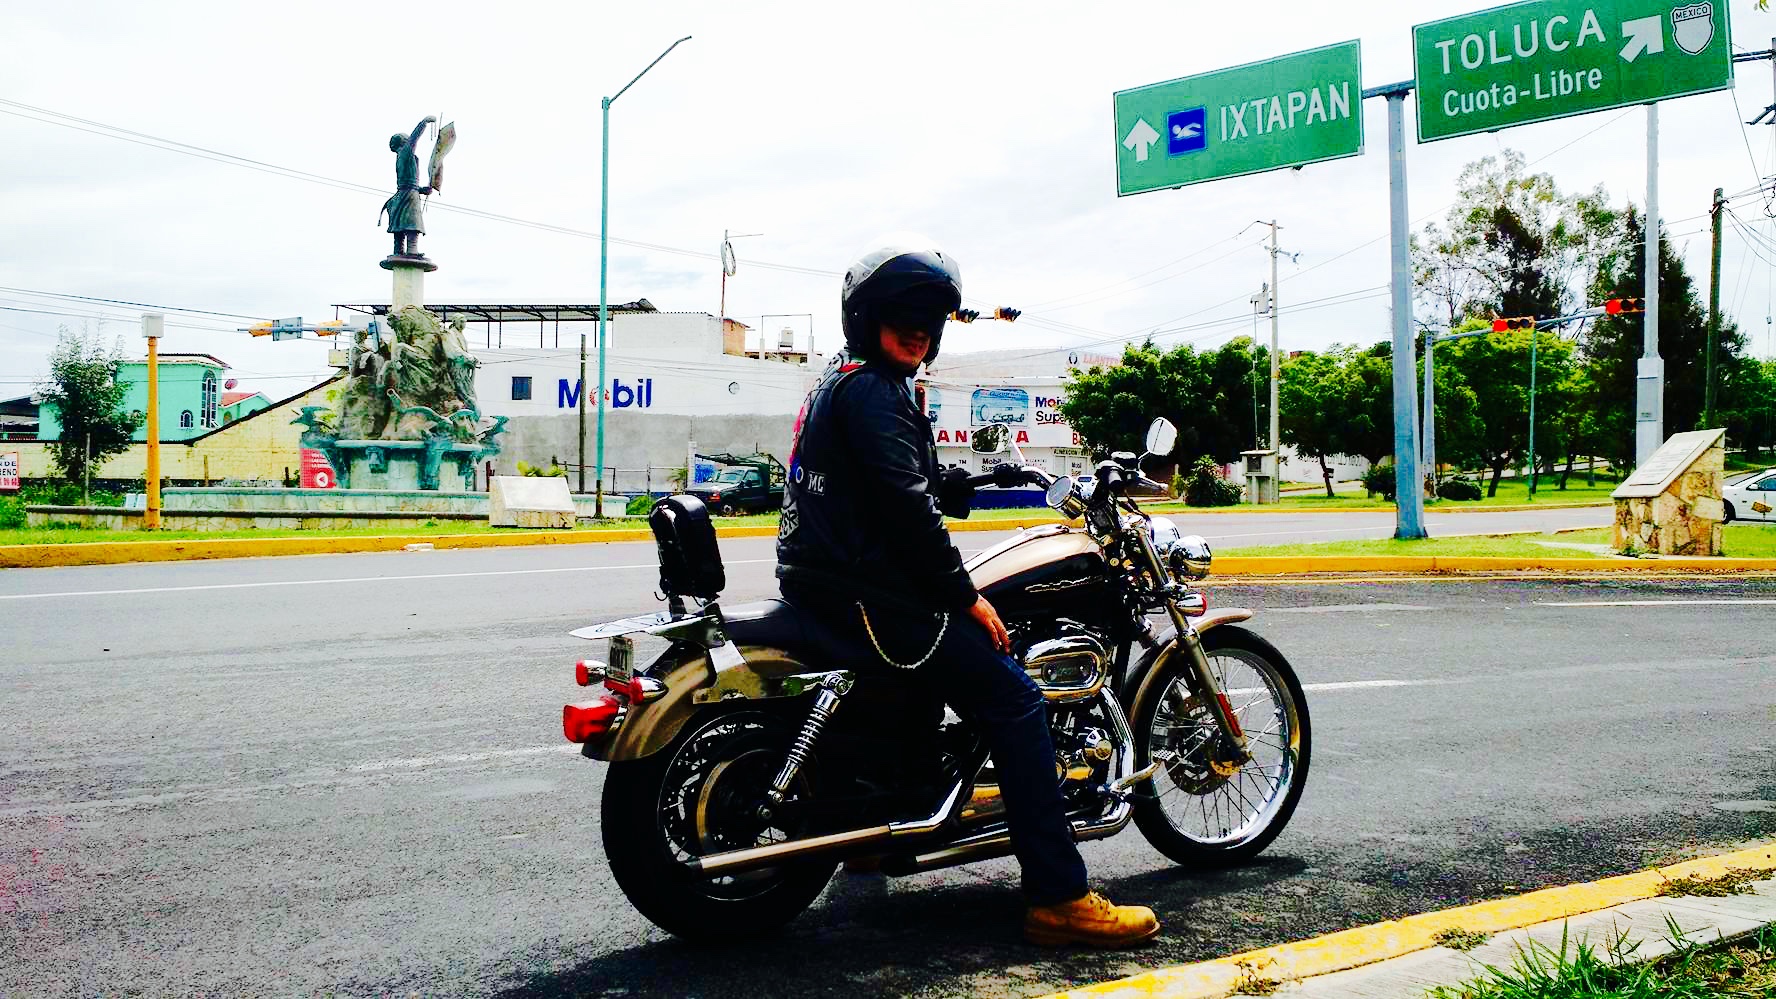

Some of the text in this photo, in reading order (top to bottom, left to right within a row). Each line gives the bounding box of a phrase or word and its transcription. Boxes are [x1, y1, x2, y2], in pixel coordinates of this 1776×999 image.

[1675, 6, 1708, 20] MEXICO
[1435, 8, 1606, 74] TOLUCA
[1220, 81, 1350, 142] IXTAPAN
[1443, 67, 1603, 116] Cuota-Libre
[808, 474, 825, 494] MC
